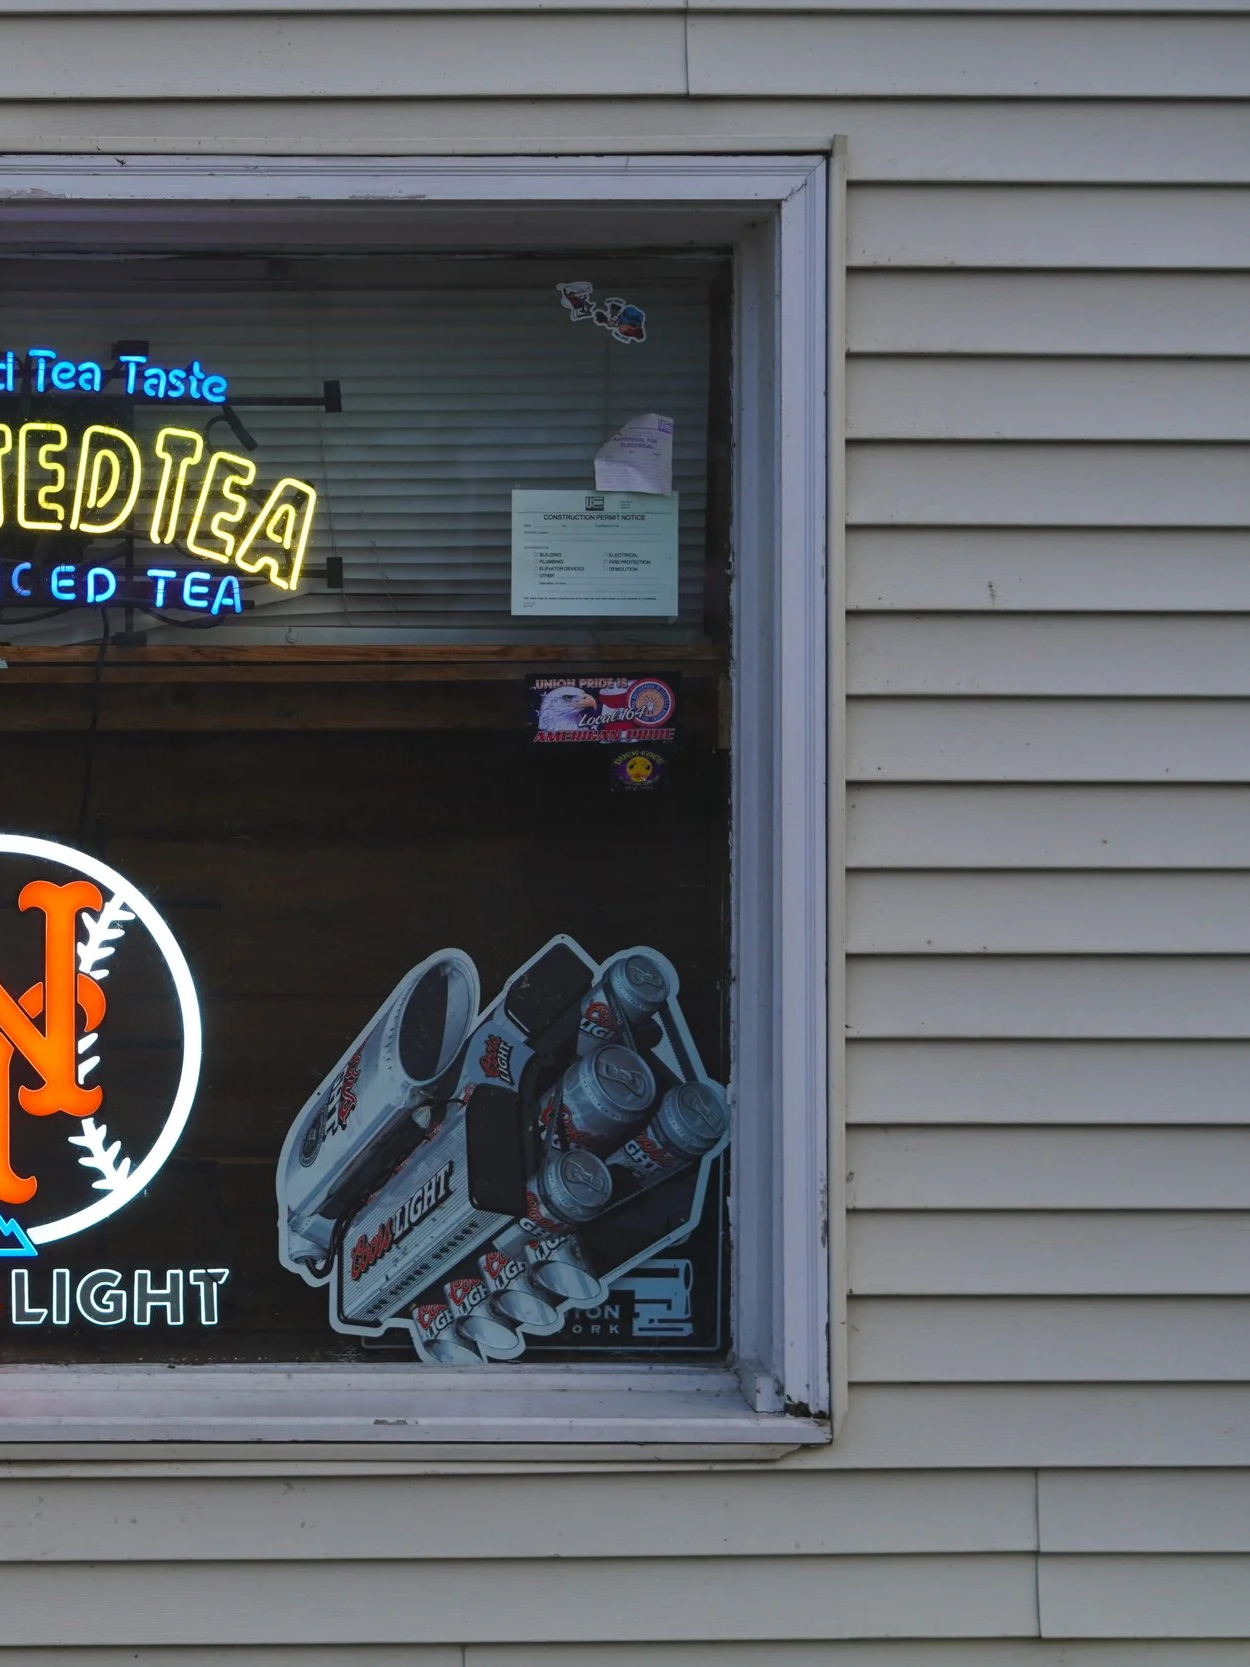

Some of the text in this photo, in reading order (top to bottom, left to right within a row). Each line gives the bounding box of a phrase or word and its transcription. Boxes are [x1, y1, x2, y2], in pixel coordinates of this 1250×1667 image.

[29, 349, 102, 393] Tea
[119, 355, 228, 403] Taste
[150, 427, 317, 591] TEA
[146, 568, 243, 616] TEA
[534, 678, 628, 689] UNION PRIDE IS
[533, 728, 676, 743] AMERICAN PRIDE
[578, 706, 646, 728] Local 164
[498, 1040, 515, 1086] LIGHT
[350, 1217, 394, 1280] Coors
[394, 1161, 454, 1240] LIGHT
[10, 1268, 231, 1326] LIGHT
